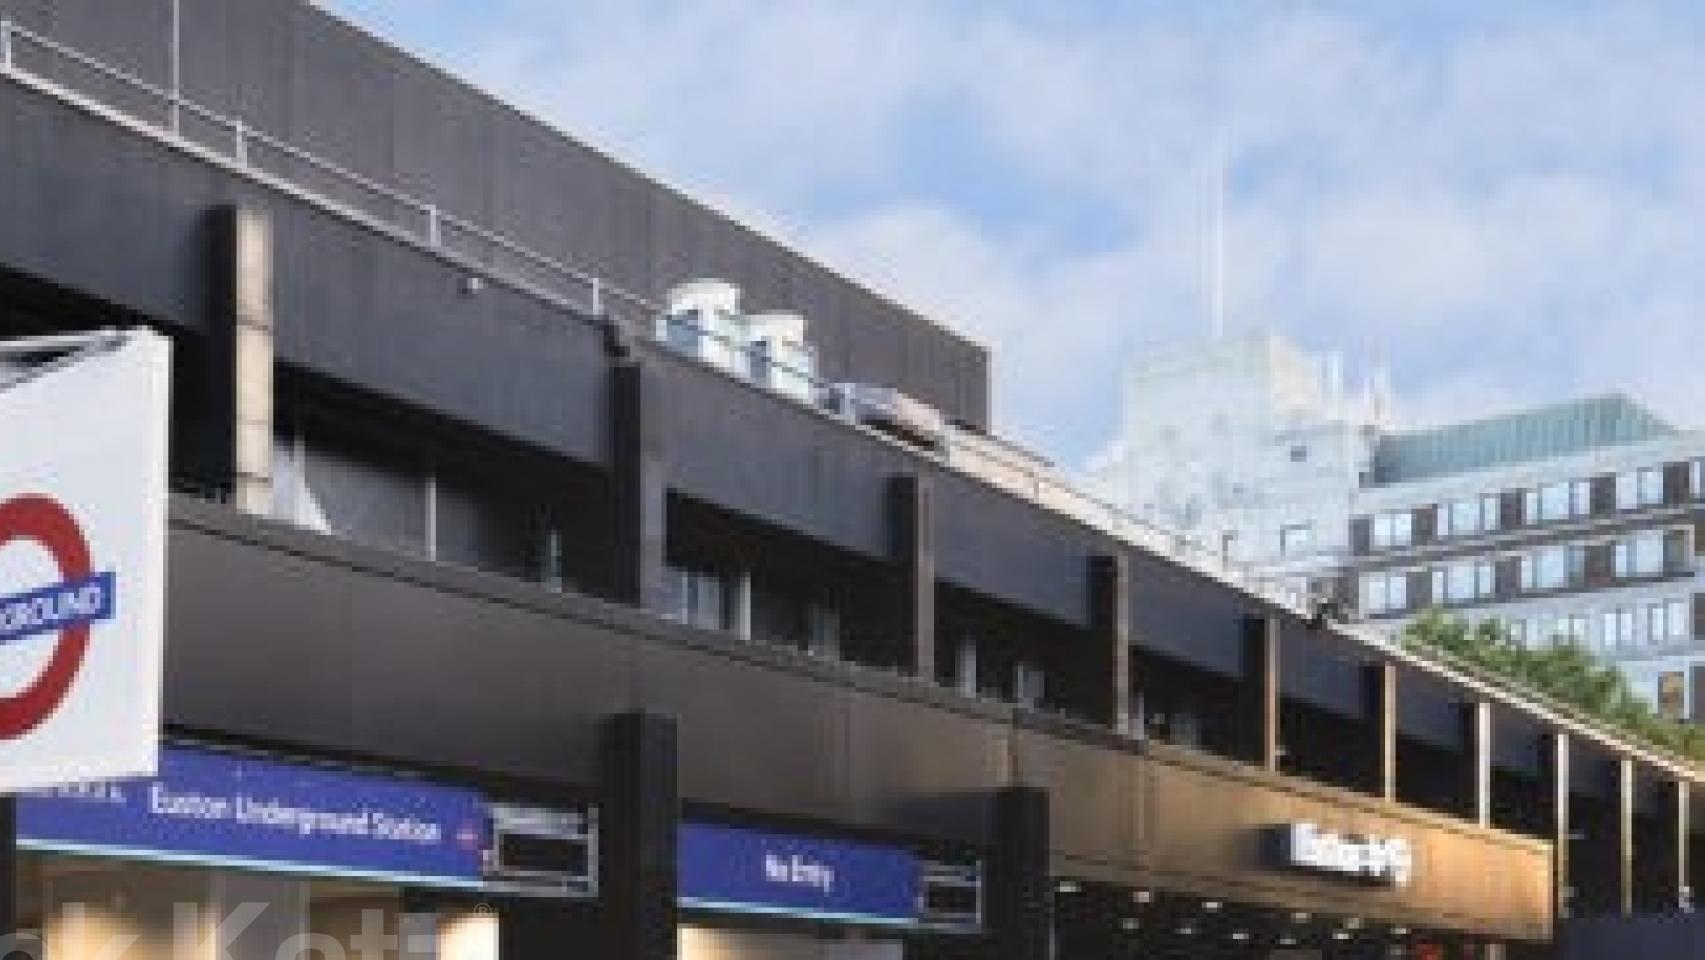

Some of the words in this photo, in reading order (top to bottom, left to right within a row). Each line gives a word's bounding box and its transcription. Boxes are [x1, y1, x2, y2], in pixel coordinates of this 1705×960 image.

[152, 781, 228, 820] Euston
[235, 798, 368, 837] Underground
[371, 812, 442, 845] Station
